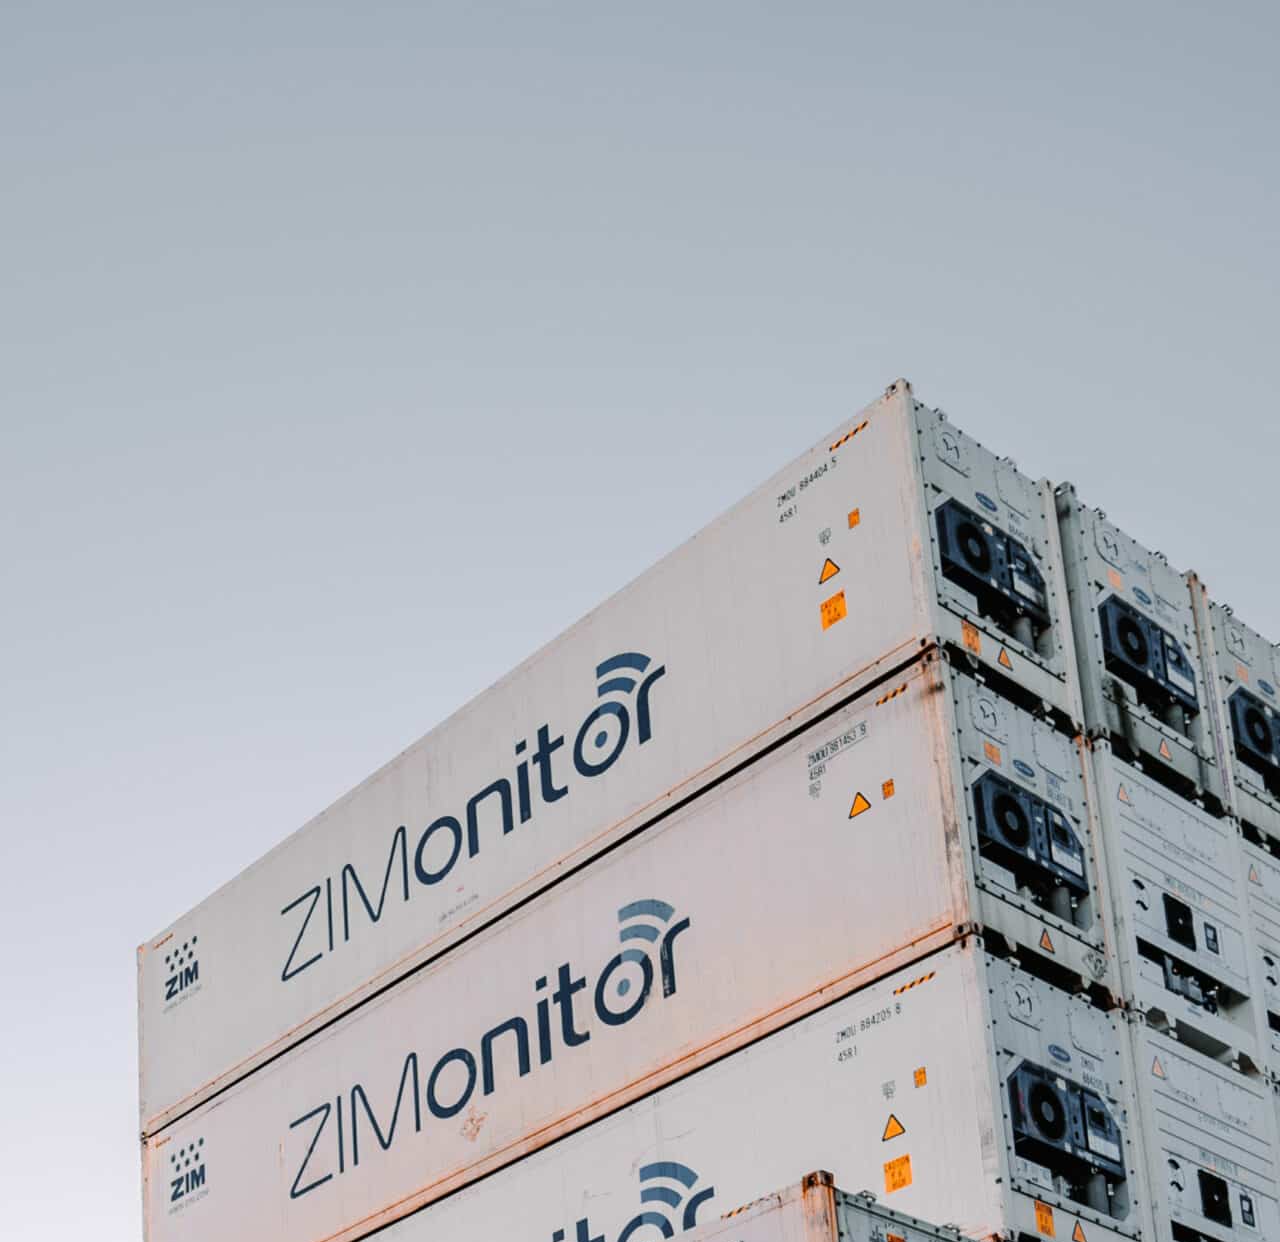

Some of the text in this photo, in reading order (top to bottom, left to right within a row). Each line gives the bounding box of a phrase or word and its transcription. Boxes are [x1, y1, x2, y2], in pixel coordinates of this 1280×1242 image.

[281, 652, 666, 982] ZIMonitor
[165, 959, 199, 1002] ZIM
[289, 899, 691, 1200] ZIMonitor
[170, 1163, 206, 1203] ZIM
